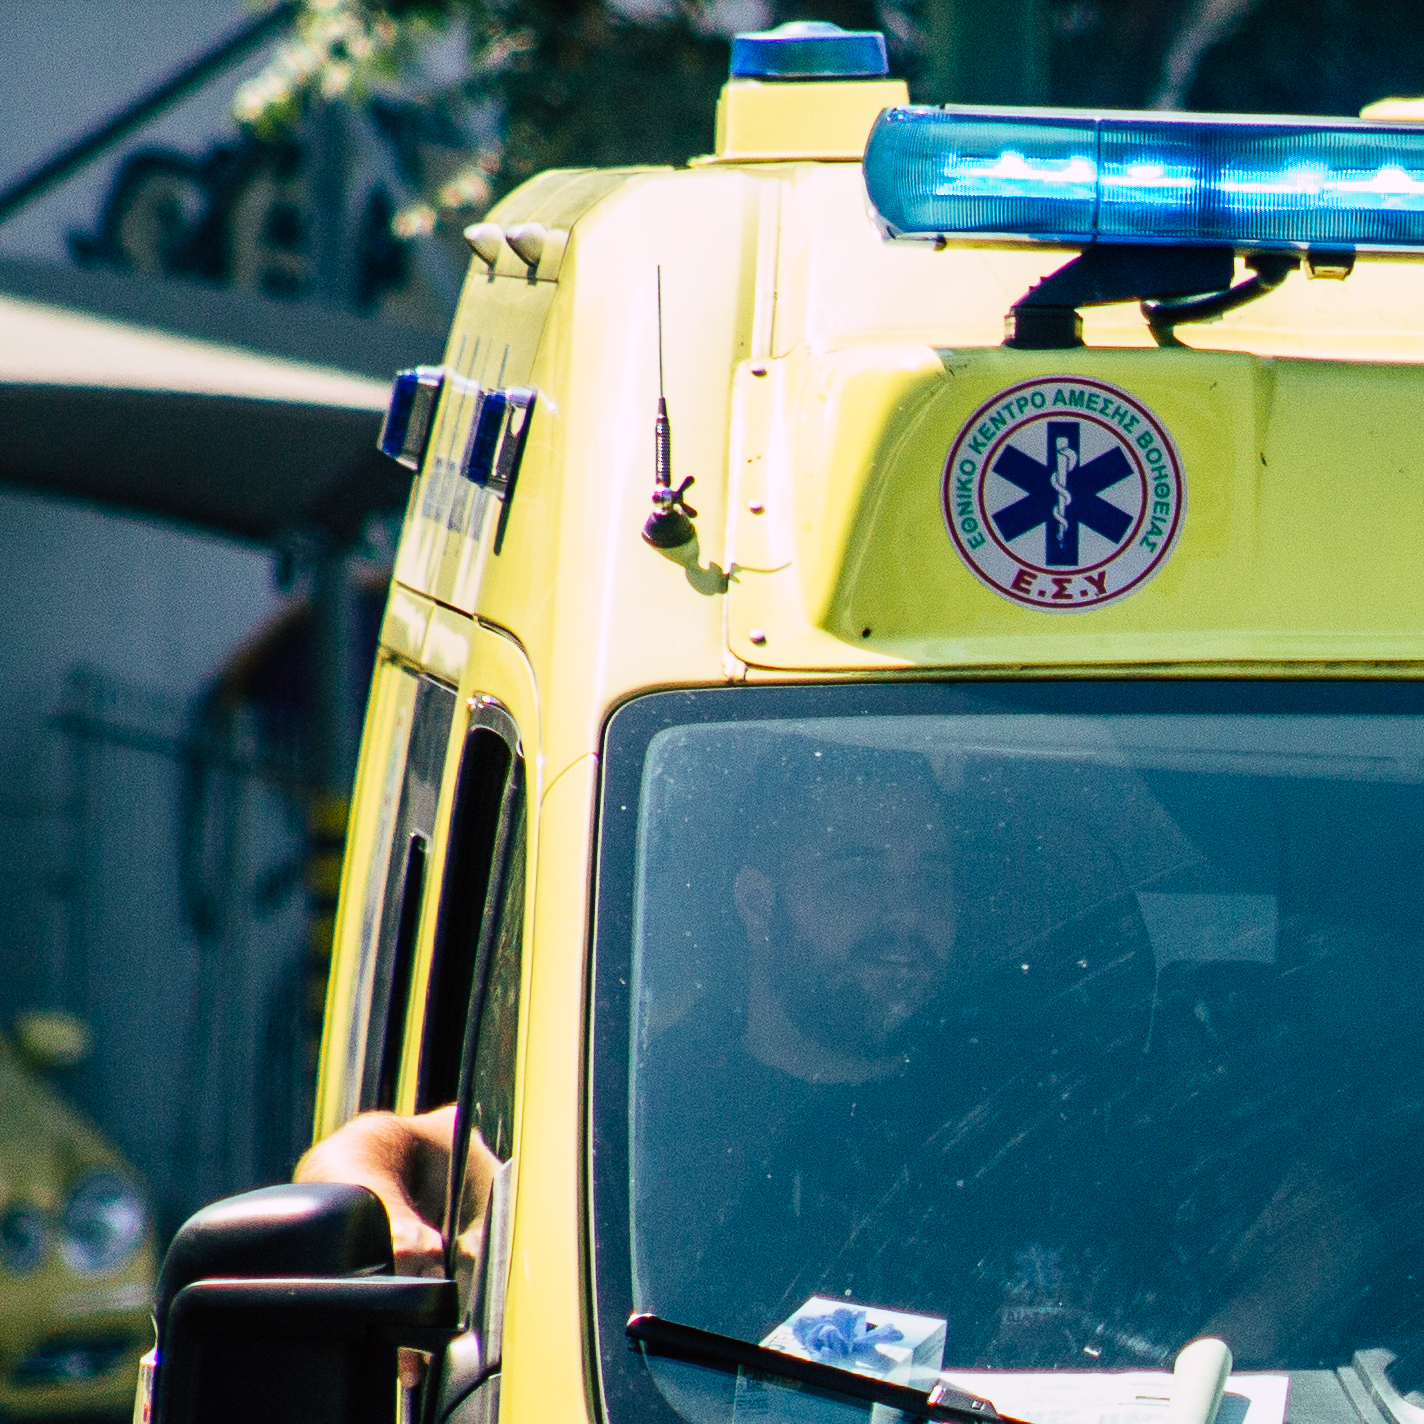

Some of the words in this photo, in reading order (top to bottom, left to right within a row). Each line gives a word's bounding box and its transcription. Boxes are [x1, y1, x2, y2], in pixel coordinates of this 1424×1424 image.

[968, 391, 1047, 455] ΚΕΝΤΡΟ
[1052, 388, 1141, 435] ΑΜΕΣΗΣ
[956, 458, 986, 550] ΕΘΝΙΚΟ
[1136, 430, 1172, 554] ΒΟΗΘΕΙΑΣ
